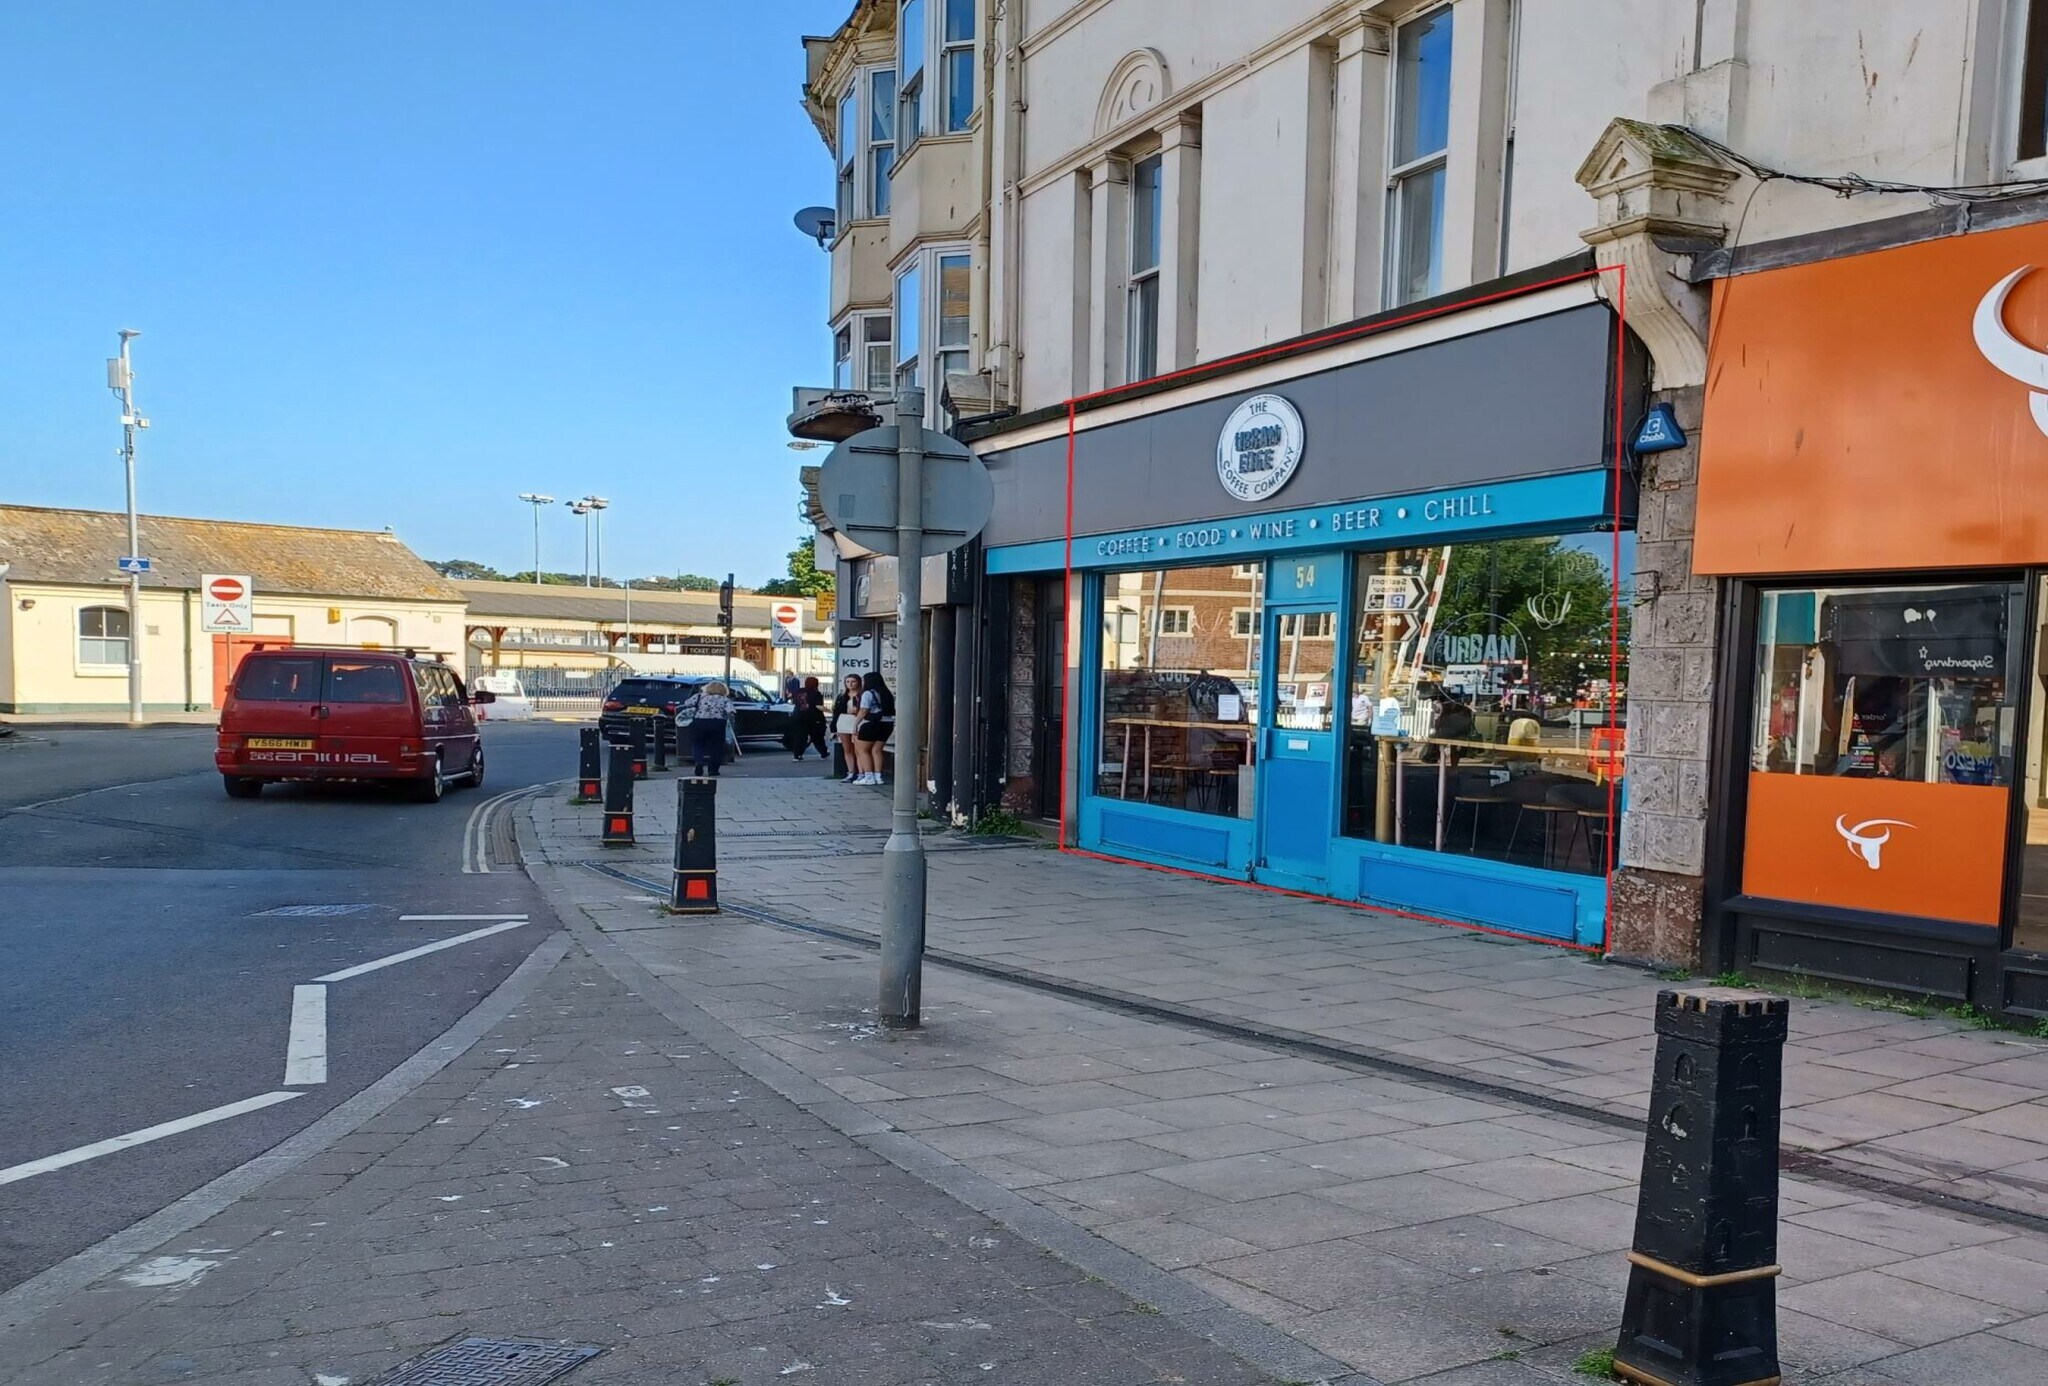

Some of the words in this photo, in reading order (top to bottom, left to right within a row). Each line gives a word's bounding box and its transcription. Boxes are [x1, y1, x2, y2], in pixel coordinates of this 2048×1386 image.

[1249, 401, 1268, 415] THE
[1235, 424, 1281, 452] URBAN
[1640, 432, 1665, 443] Chubb
[1223, 460, 1249, 495] COFFEE
[1253, 446, 1294, 495] COMPANY
[1239, 449, 1274, 474] EDGE
[1097, 536, 1149, 556] COFFEE
[1177, 528, 1220, 549] FOOD
[1250, 518, 1294, 540] WINE
[1332, 508, 1379, 531] BEER
[1424, 493, 1491, 521] CHILL
[1296, 564, 1315, 589] 54
[1443, 633, 1516, 663] URBAN
[842, 658, 870, 668] KEYS
